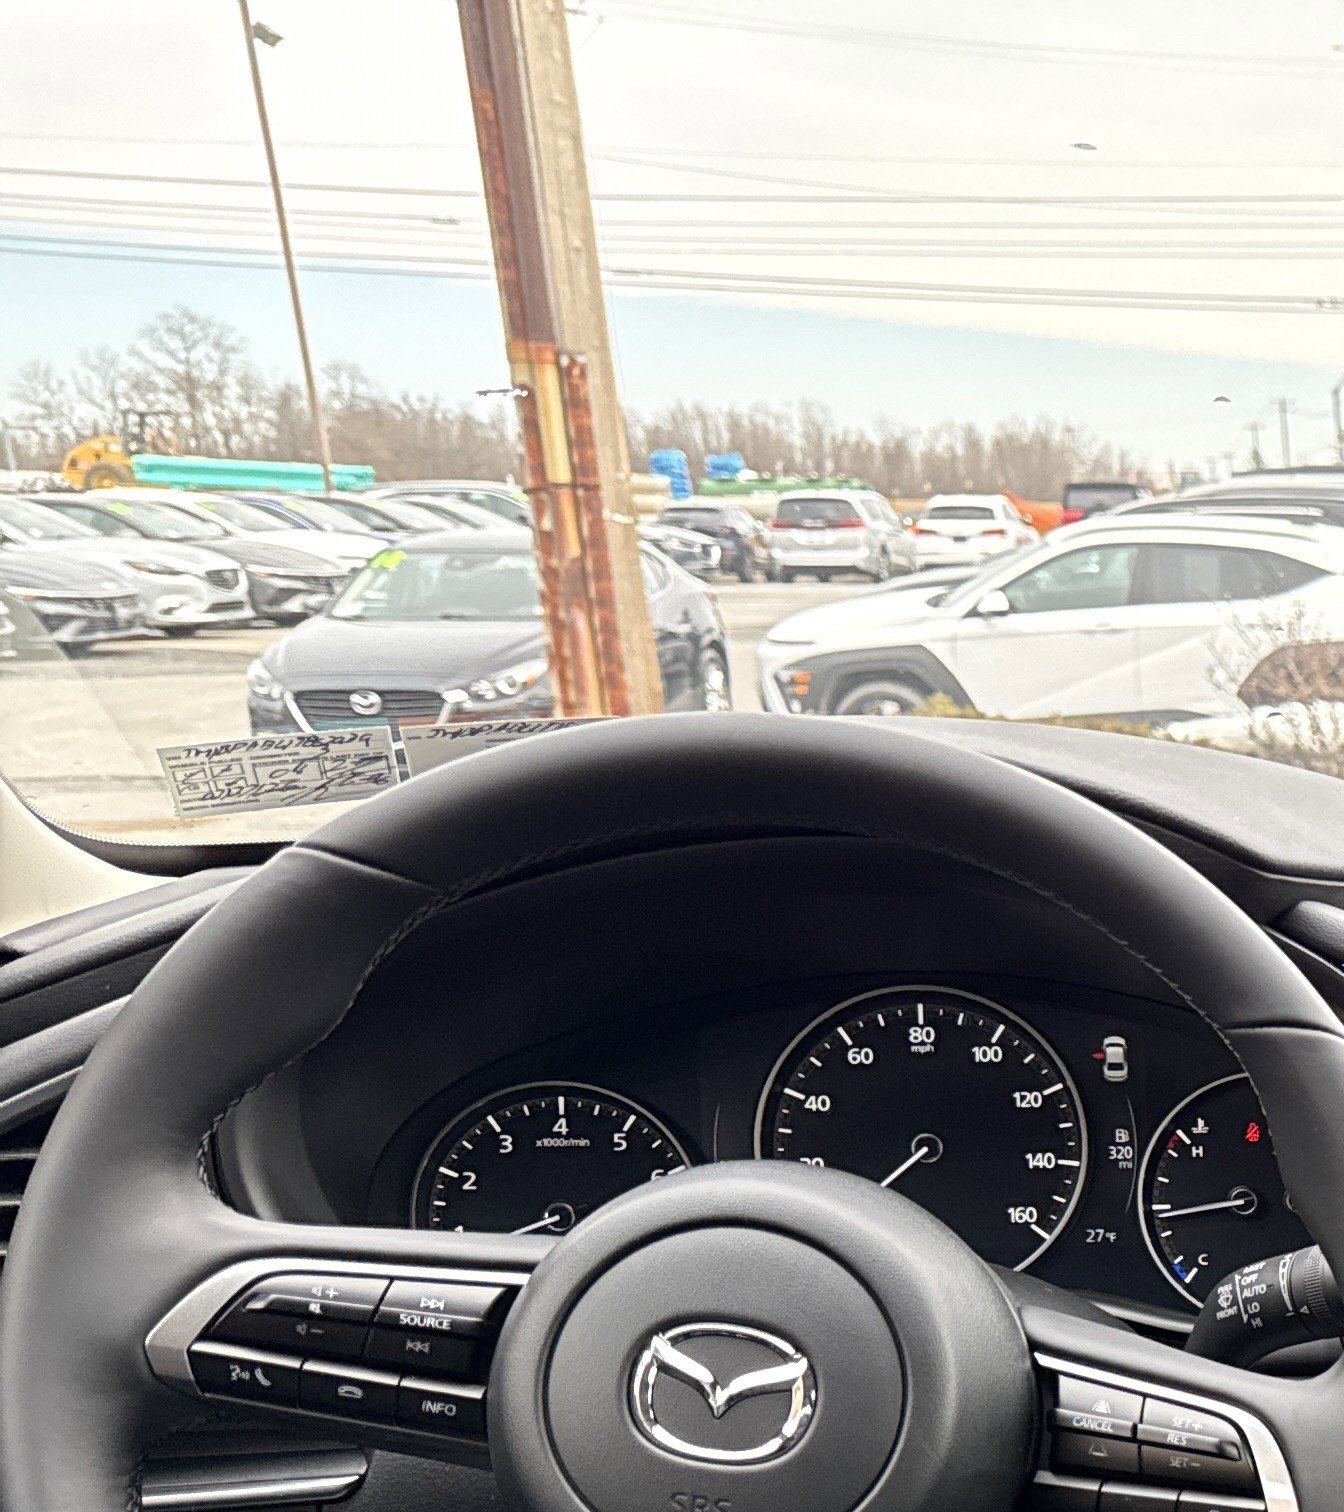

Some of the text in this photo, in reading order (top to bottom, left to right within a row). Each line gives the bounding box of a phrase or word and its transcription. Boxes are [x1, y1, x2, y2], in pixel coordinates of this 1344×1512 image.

[909, 1027, 935, 1044] 80
[847, 1048, 874, 1065] 60
[910, 1044, 934, 1054] mph
[972, 1046, 1002, 1063] 100
[804, 1095, 831, 1111] 40
[1013, 1091, 1043, 1108] 120
[552, 1118, 569, 1135] 4
[499, 1135, 513, 1153] 3
[613, 1133, 627, 1151] 5
[1108, 1147, 1133, 1160] 320
[1191, 1146, 1203, 1157] H
[1025, 1152, 1056, 1169] 140
[1119, 1161, 1132, 1169] mi
[462, 1172, 477, 1190] 2
[1007, 1207, 1037, 1223] 160
[1198, 1254, 1209, 1266] C
[1242, 1284, 1266, 1299] AUTO
[1247, 1302, 1260, 1314] LO
[399, 1314, 451, 1329] SOURCE
[422, 1400, 456, 1416] INFO
[1072, 1417, 1114, 1432] CANCEL
[1166, 1433, 1188, 1446] RES
